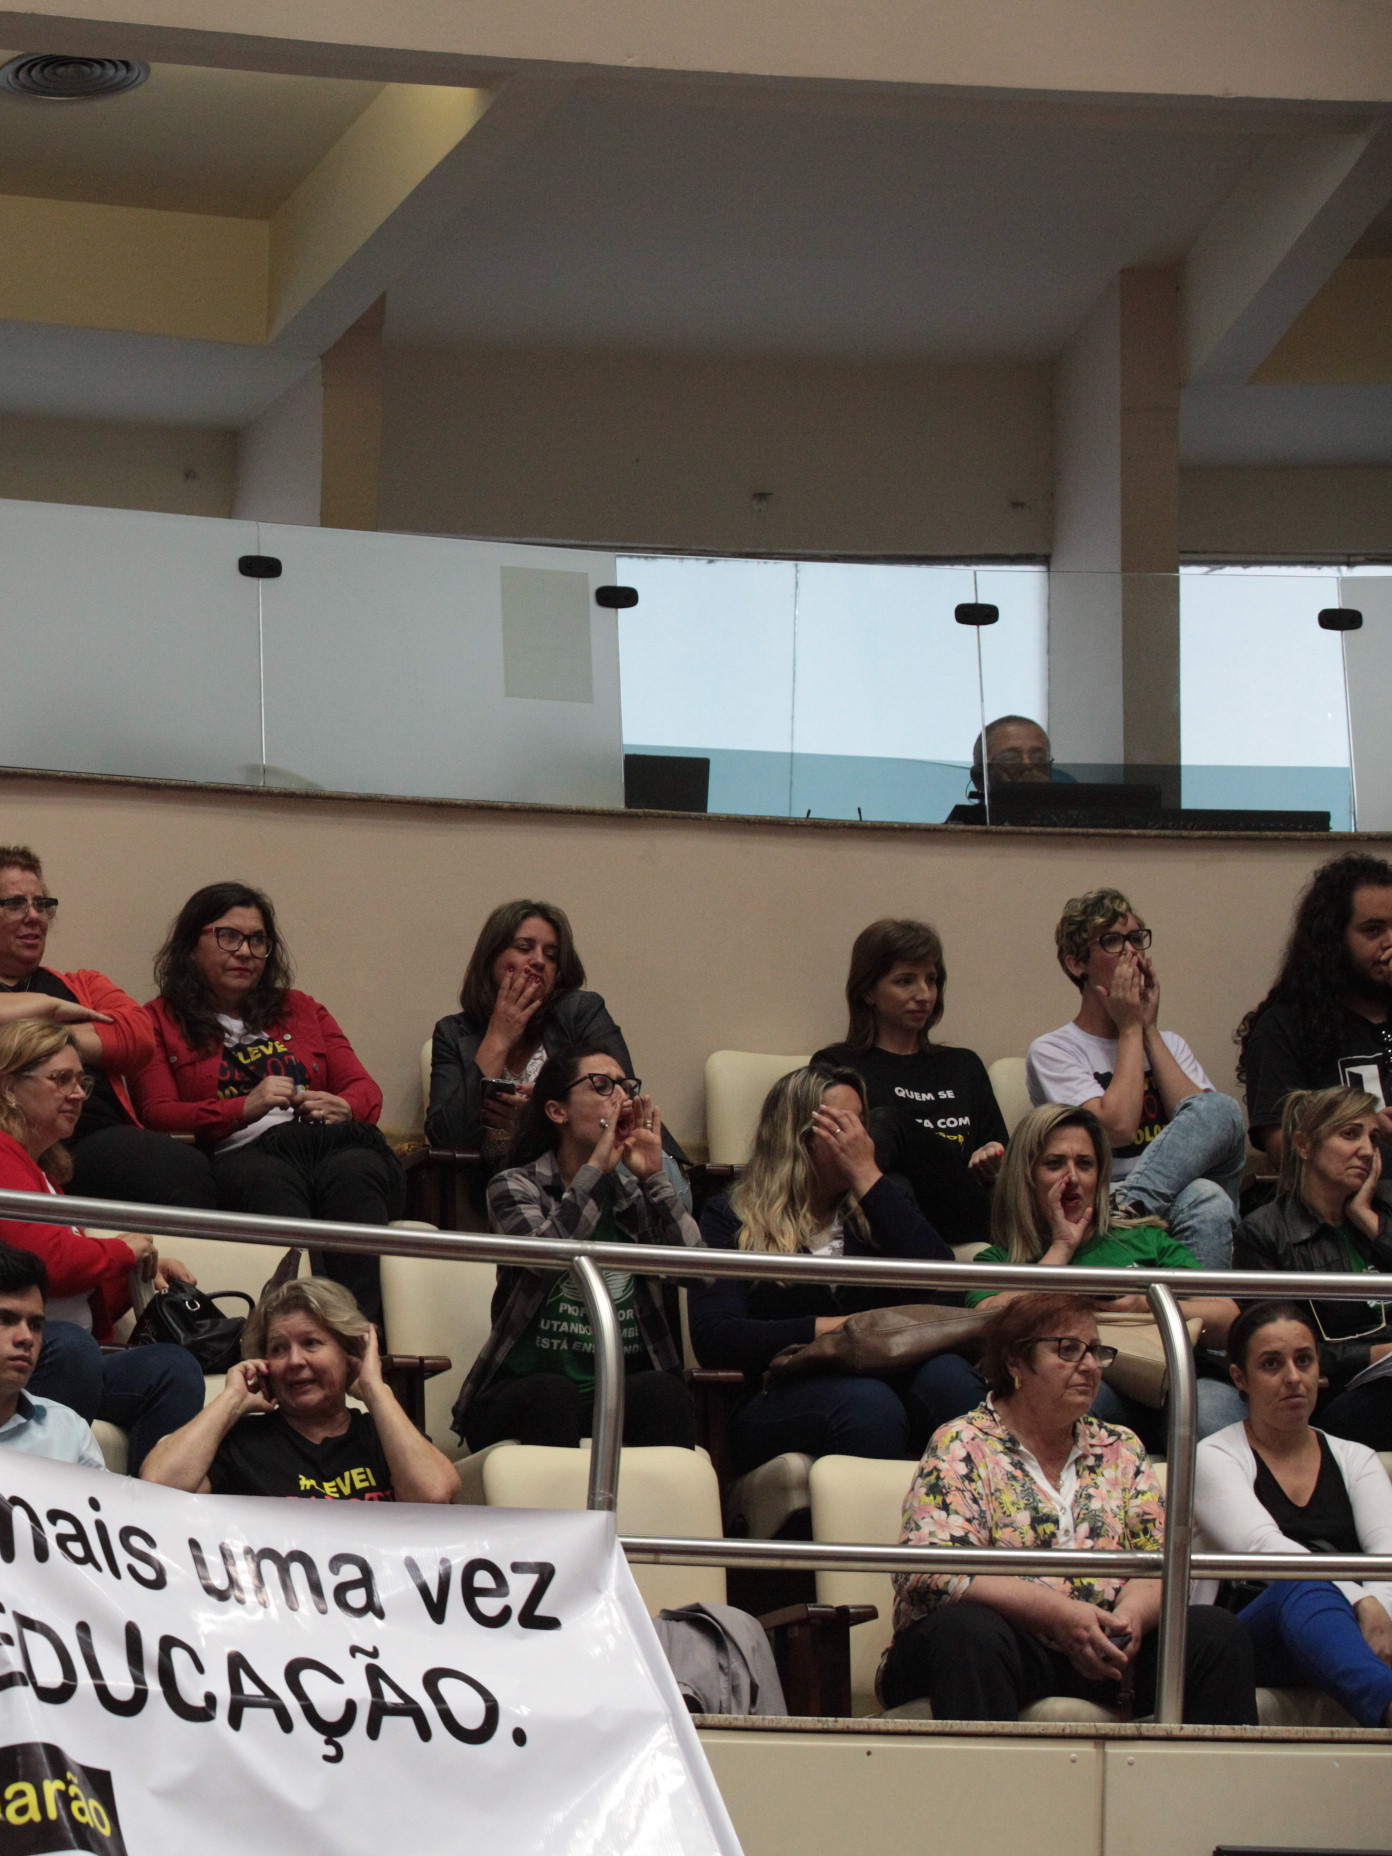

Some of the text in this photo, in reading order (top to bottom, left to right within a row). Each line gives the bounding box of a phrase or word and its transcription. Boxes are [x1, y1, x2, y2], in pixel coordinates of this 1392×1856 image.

[894, 1086, 955, 1101] QUEM SE
[936, 1116, 971, 1129] COM
[540, 1318, 593, 1337] UTANDO
[187, 1537, 386, 1620] uma
[405, 1555, 562, 1631] vez
